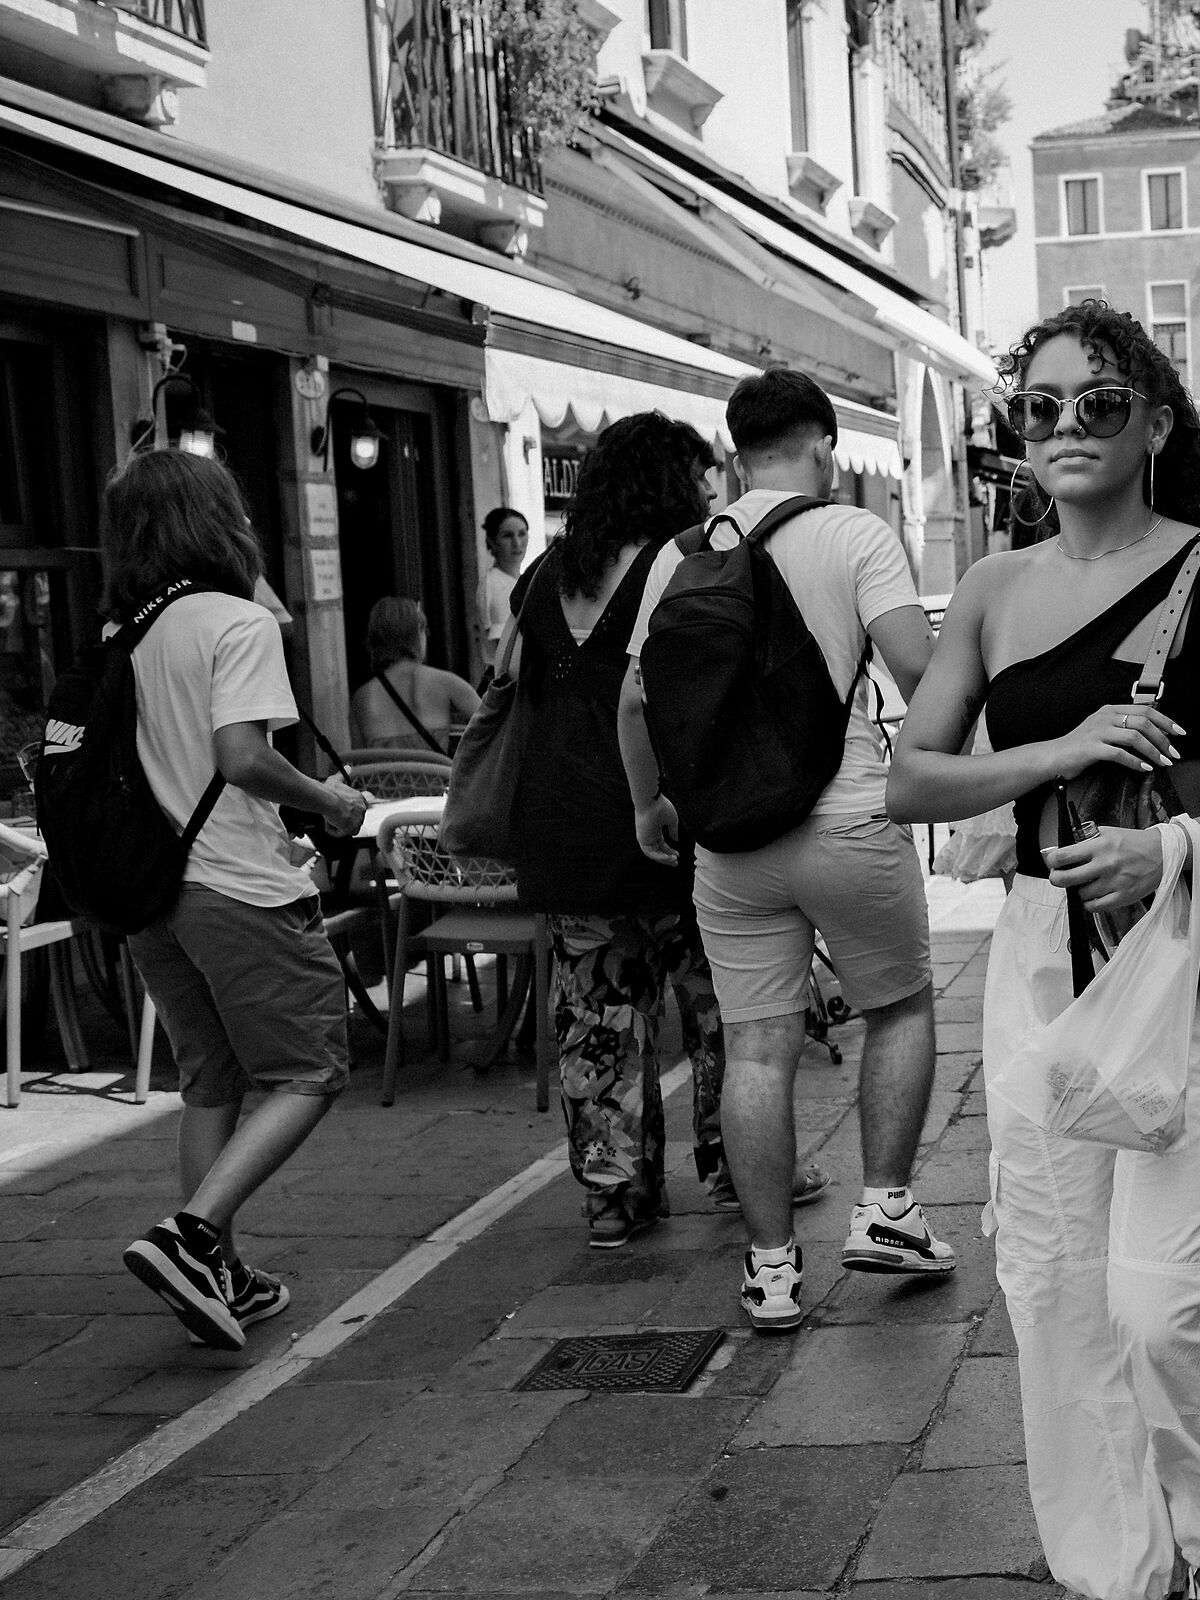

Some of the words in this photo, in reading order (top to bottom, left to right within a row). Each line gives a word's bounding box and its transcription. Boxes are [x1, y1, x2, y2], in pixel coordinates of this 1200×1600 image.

[133, 595, 164, 624] NIKE
[167, 579, 192, 596] AIR
[45, 718, 86, 746] NIKE
[585, 1352, 651, 1371] GAS
